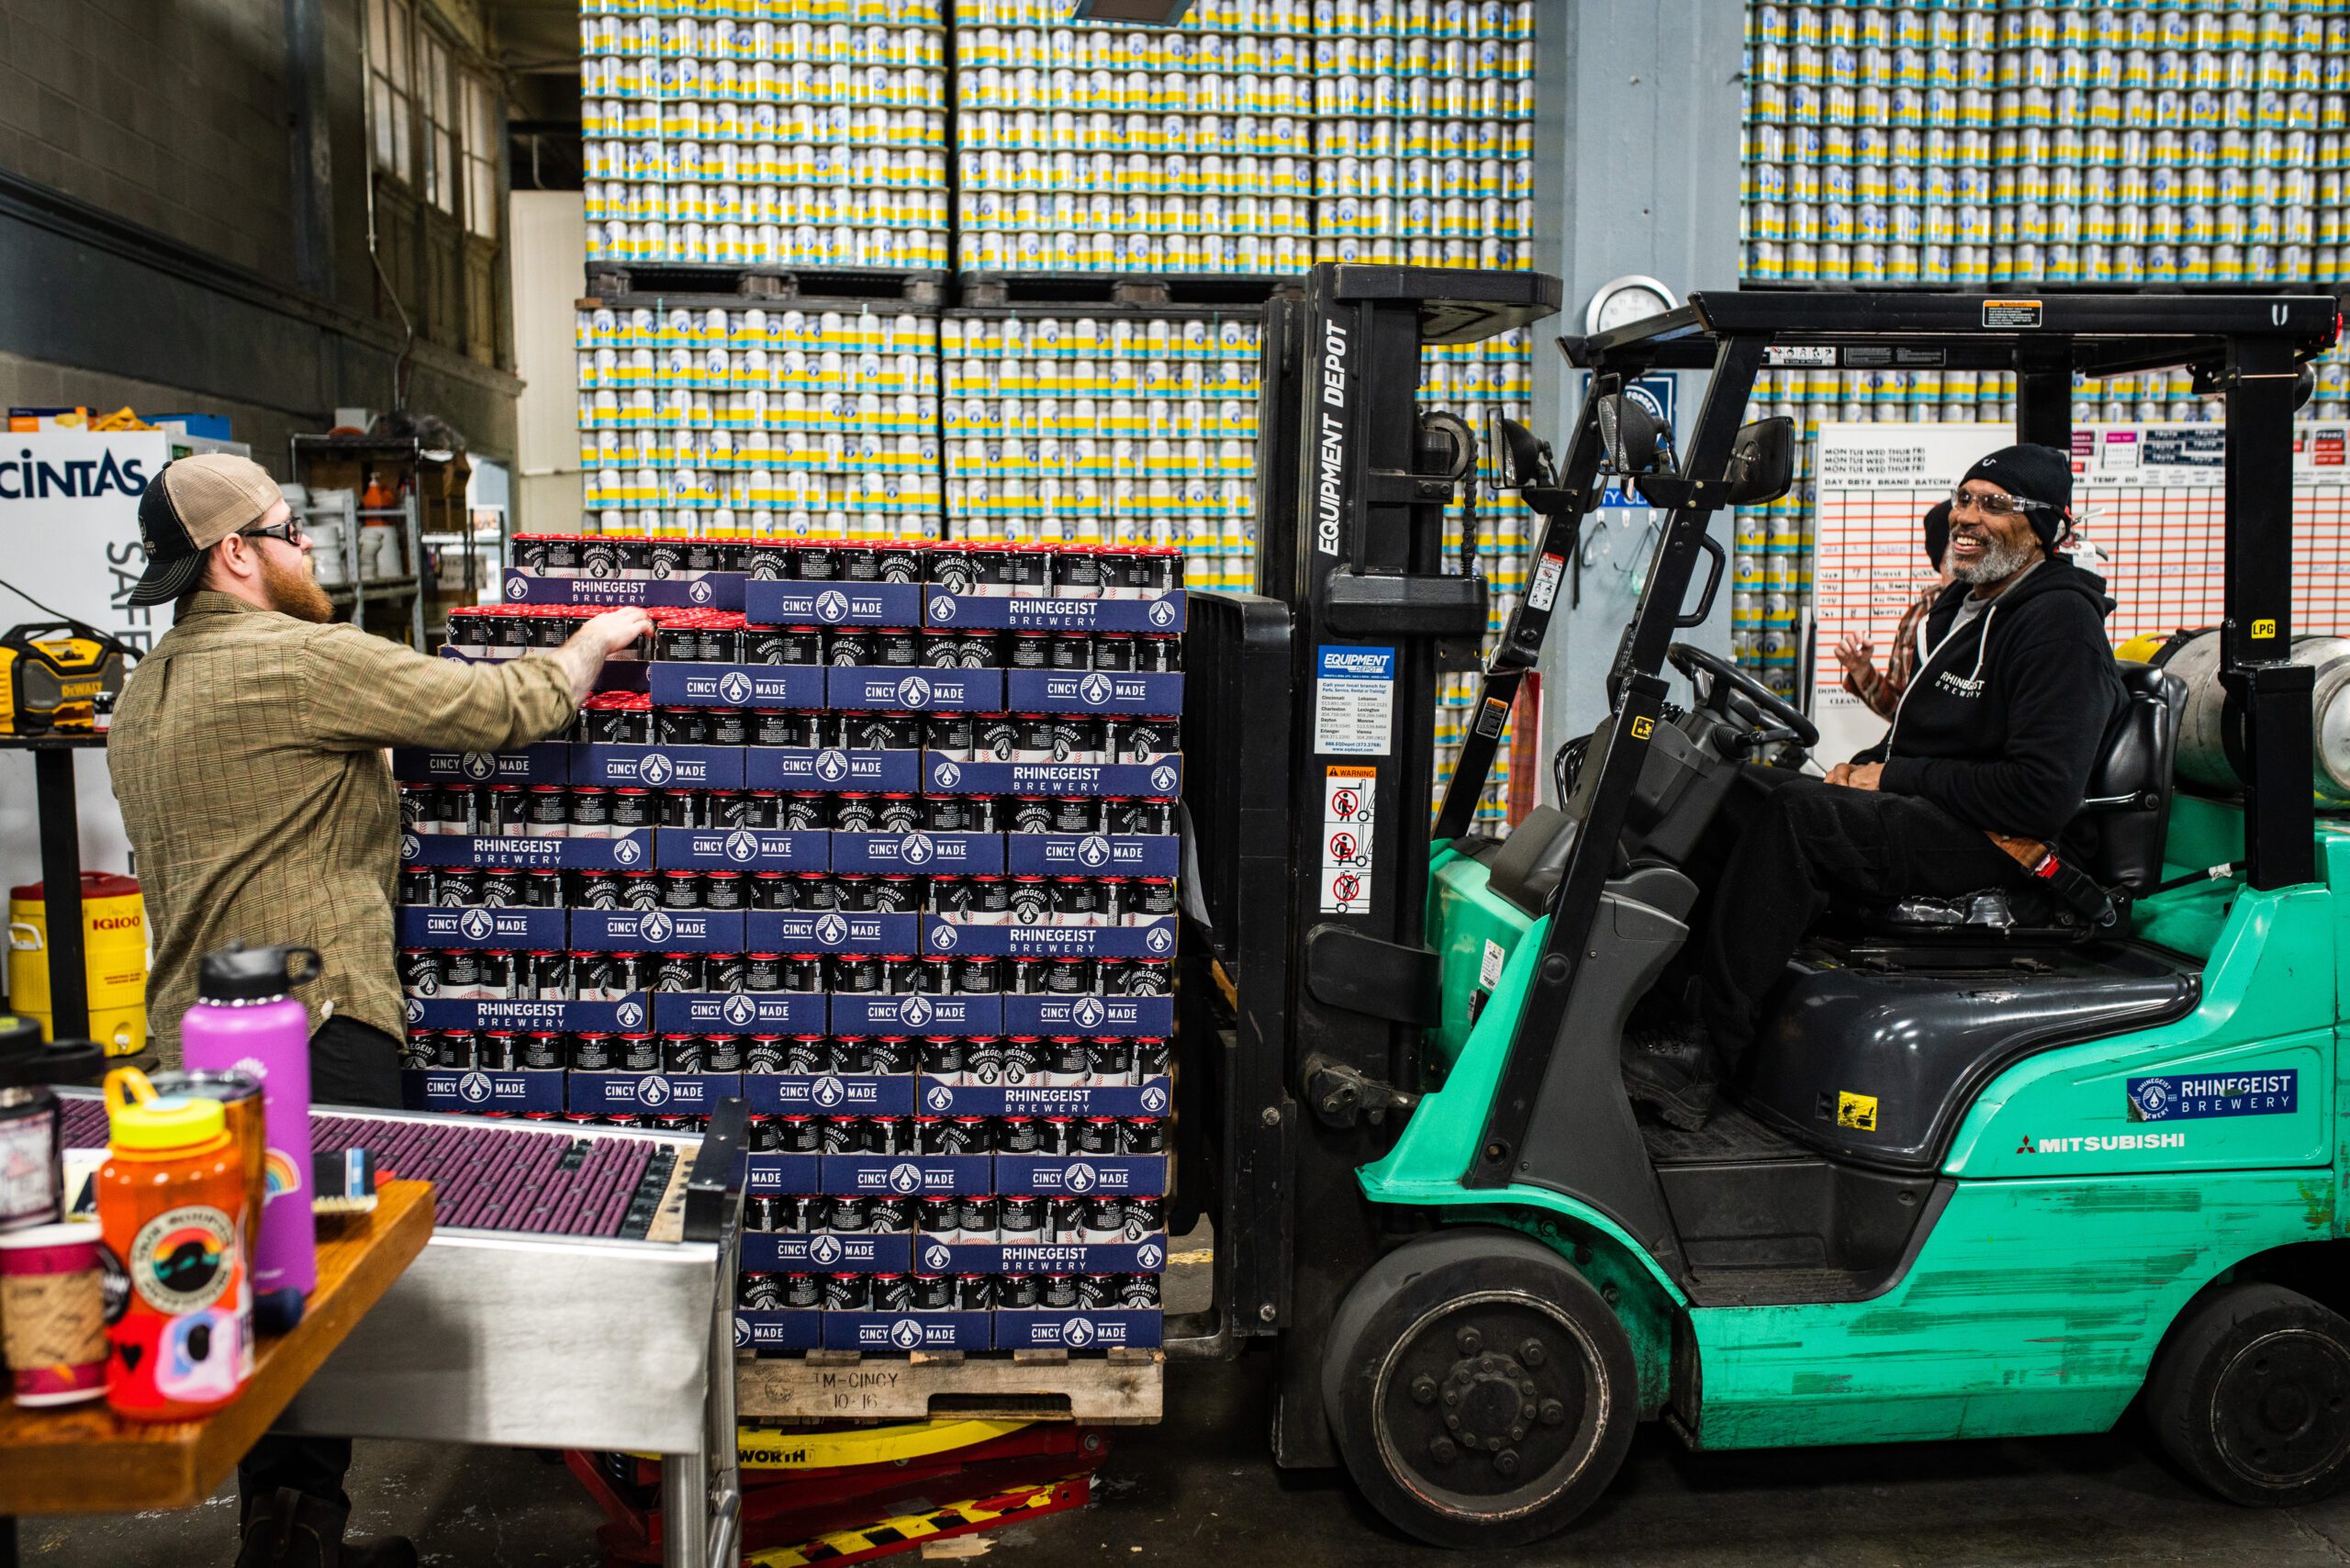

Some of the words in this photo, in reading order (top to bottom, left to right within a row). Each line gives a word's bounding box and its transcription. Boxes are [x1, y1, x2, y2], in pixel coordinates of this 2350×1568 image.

[1324, 319, 1347, 408] DEPOT
[0, 447, 149, 498] CINTAS
[1318, 413, 1343, 556] EQUIPMENT
[573, 581, 645, 593] RHINEGEIST
[783, 601, 812, 611] CINCY
[853, 603, 881, 612] MADE
[1011, 601, 1097, 614] RHINEGEIST
[1010, 616, 1095, 625] BREWERY
[2254, 624, 2273, 634] LPG
[1324, 654, 1390, 666] EQUIPMENT
[688, 682, 716, 692] CINCY
[756, 685, 785, 694] MADE
[866, 688, 895, 697] CINCY
[934, 689, 963, 699] MADE
[1048, 684, 1077, 693] CINCY
[1116, 686, 1145, 695] MADE
[431, 759, 459, 768] CINCY
[500, 761, 529, 770] MADE
[608, 764, 636, 774] CINCY
[677, 767, 705, 776] MADE
[784, 761, 812, 770] CINCY
[852, 763, 880, 772] MADE
[1014, 767, 1100, 779] RHINEGEIST
[1014, 782, 1098, 790] BREWERY
[475, 840, 561, 853] RHINEGEIST
[694, 842, 722, 851] CINCY
[763, 843, 790, 852] MADE
[869, 845, 898, 854] CINCY
[937, 846, 966, 855] MADE
[1046, 846, 1075, 856] CINCY
[1114, 848, 1142, 857] MADE
[475, 855, 560, 863] BREWERY
[93, 916, 140, 930] IGLOO
[429, 920, 457, 929] CINCY
[498, 921, 526, 930] MADE
[608, 923, 636, 932] CINCY
[677, 924, 705, 933] MADE
[784, 924, 811, 934] CINCY
[852, 926, 879, 935] MADE
[1011, 930, 1095, 941] RHINEGEIST
[1011, 944, 1093, 952] BREWERY
[478, 1003, 565, 1015] RHINEGEIST
[691, 1006, 720, 1014] CINCY
[760, 1007, 788, 1015] MADE
[868, 1008, 897, 1016] CINCY
[936, 1008, 965, 1016] MADE
[1041, 1008, 1069, 1017] CINCY
[1109, 1009, 1136, 1018] MADE
[478, 1018, 563, 1026] BREWERY
[428, 1083, 456, 1092] CINCY
[497, 1084, 524, 1092] MADE
[2137, 1078, 2172, 1092] RHINEGEIST
[2182, 1076, 2291, 1097] RHINEGEIST
[606, 1087, 634, 1095] CINCY
[675, 1087, 702, 1096] MADE
[780, 1087, 809, 1096] CINCY
[848, 1088, 876, 1097] MADE
[1006, 1091, 1091, 1102] RHINEGEIST
[2182, 1096, 2288, 1113] BREWERY
[2039, 1133, 2185, 1153] MITSUBISHI
[753, 1173, 780, 1182] MADE
[858, 1174, 886, 1183] CINCY
[925, 1175, 953, 1183] MADE
[1034, 1174, 1061, 1182] CINCY
[1100, 1174, 1127, 1182] MADE
[778, 1246, 806, 1254] CINCY
[845, 1246, 873, 1255] MADE
[1003, 1248, 1087, 1259] RHINEGEIST
[755, 1328, 782, 1338] MADE
[860, 1330, 888, 1338] CINCY
[927, 1330, 955, 1338] MADE
[1032, 1328, 1059, 1338] CINCY
[1098, 1328, 1125, 1337] MADE
